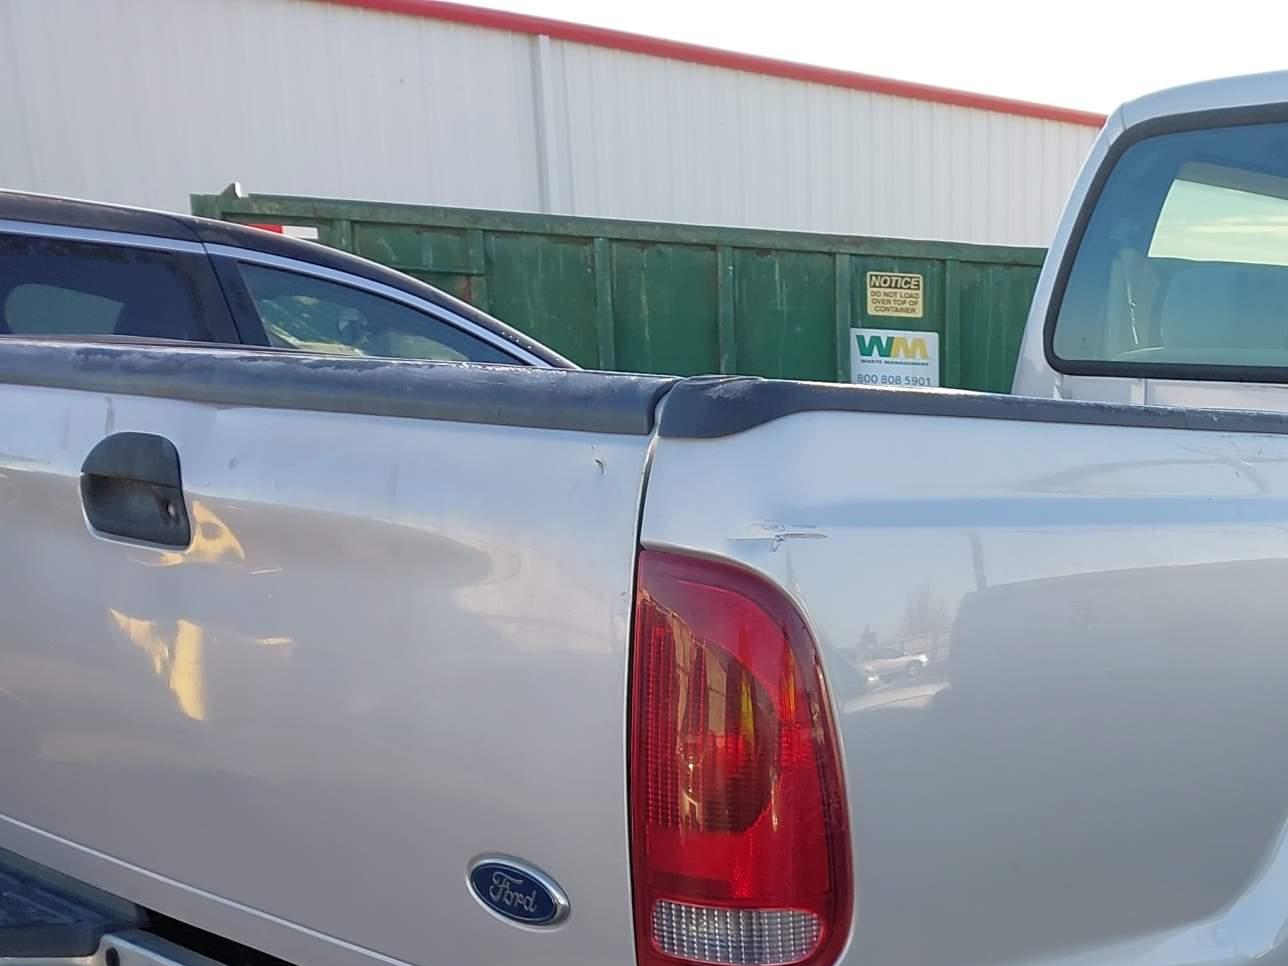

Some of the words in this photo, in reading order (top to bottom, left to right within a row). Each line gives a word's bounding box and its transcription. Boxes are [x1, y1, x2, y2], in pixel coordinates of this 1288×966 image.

[871, 276, 920, 289] NOTICE
[871, 290, 881, 298] DO
[883, 291, 898, 299] NOT
[899, 292, 920, 300] LOAD
[872, 298, 892, 306] OVER
[856, 334, 929, 360] WM
[857, 373, 878, 384] 800
[881, 374, 902, 385] 808
[904, 376, 931, 386] 5901
[489, 871, 538, 913] Ford
